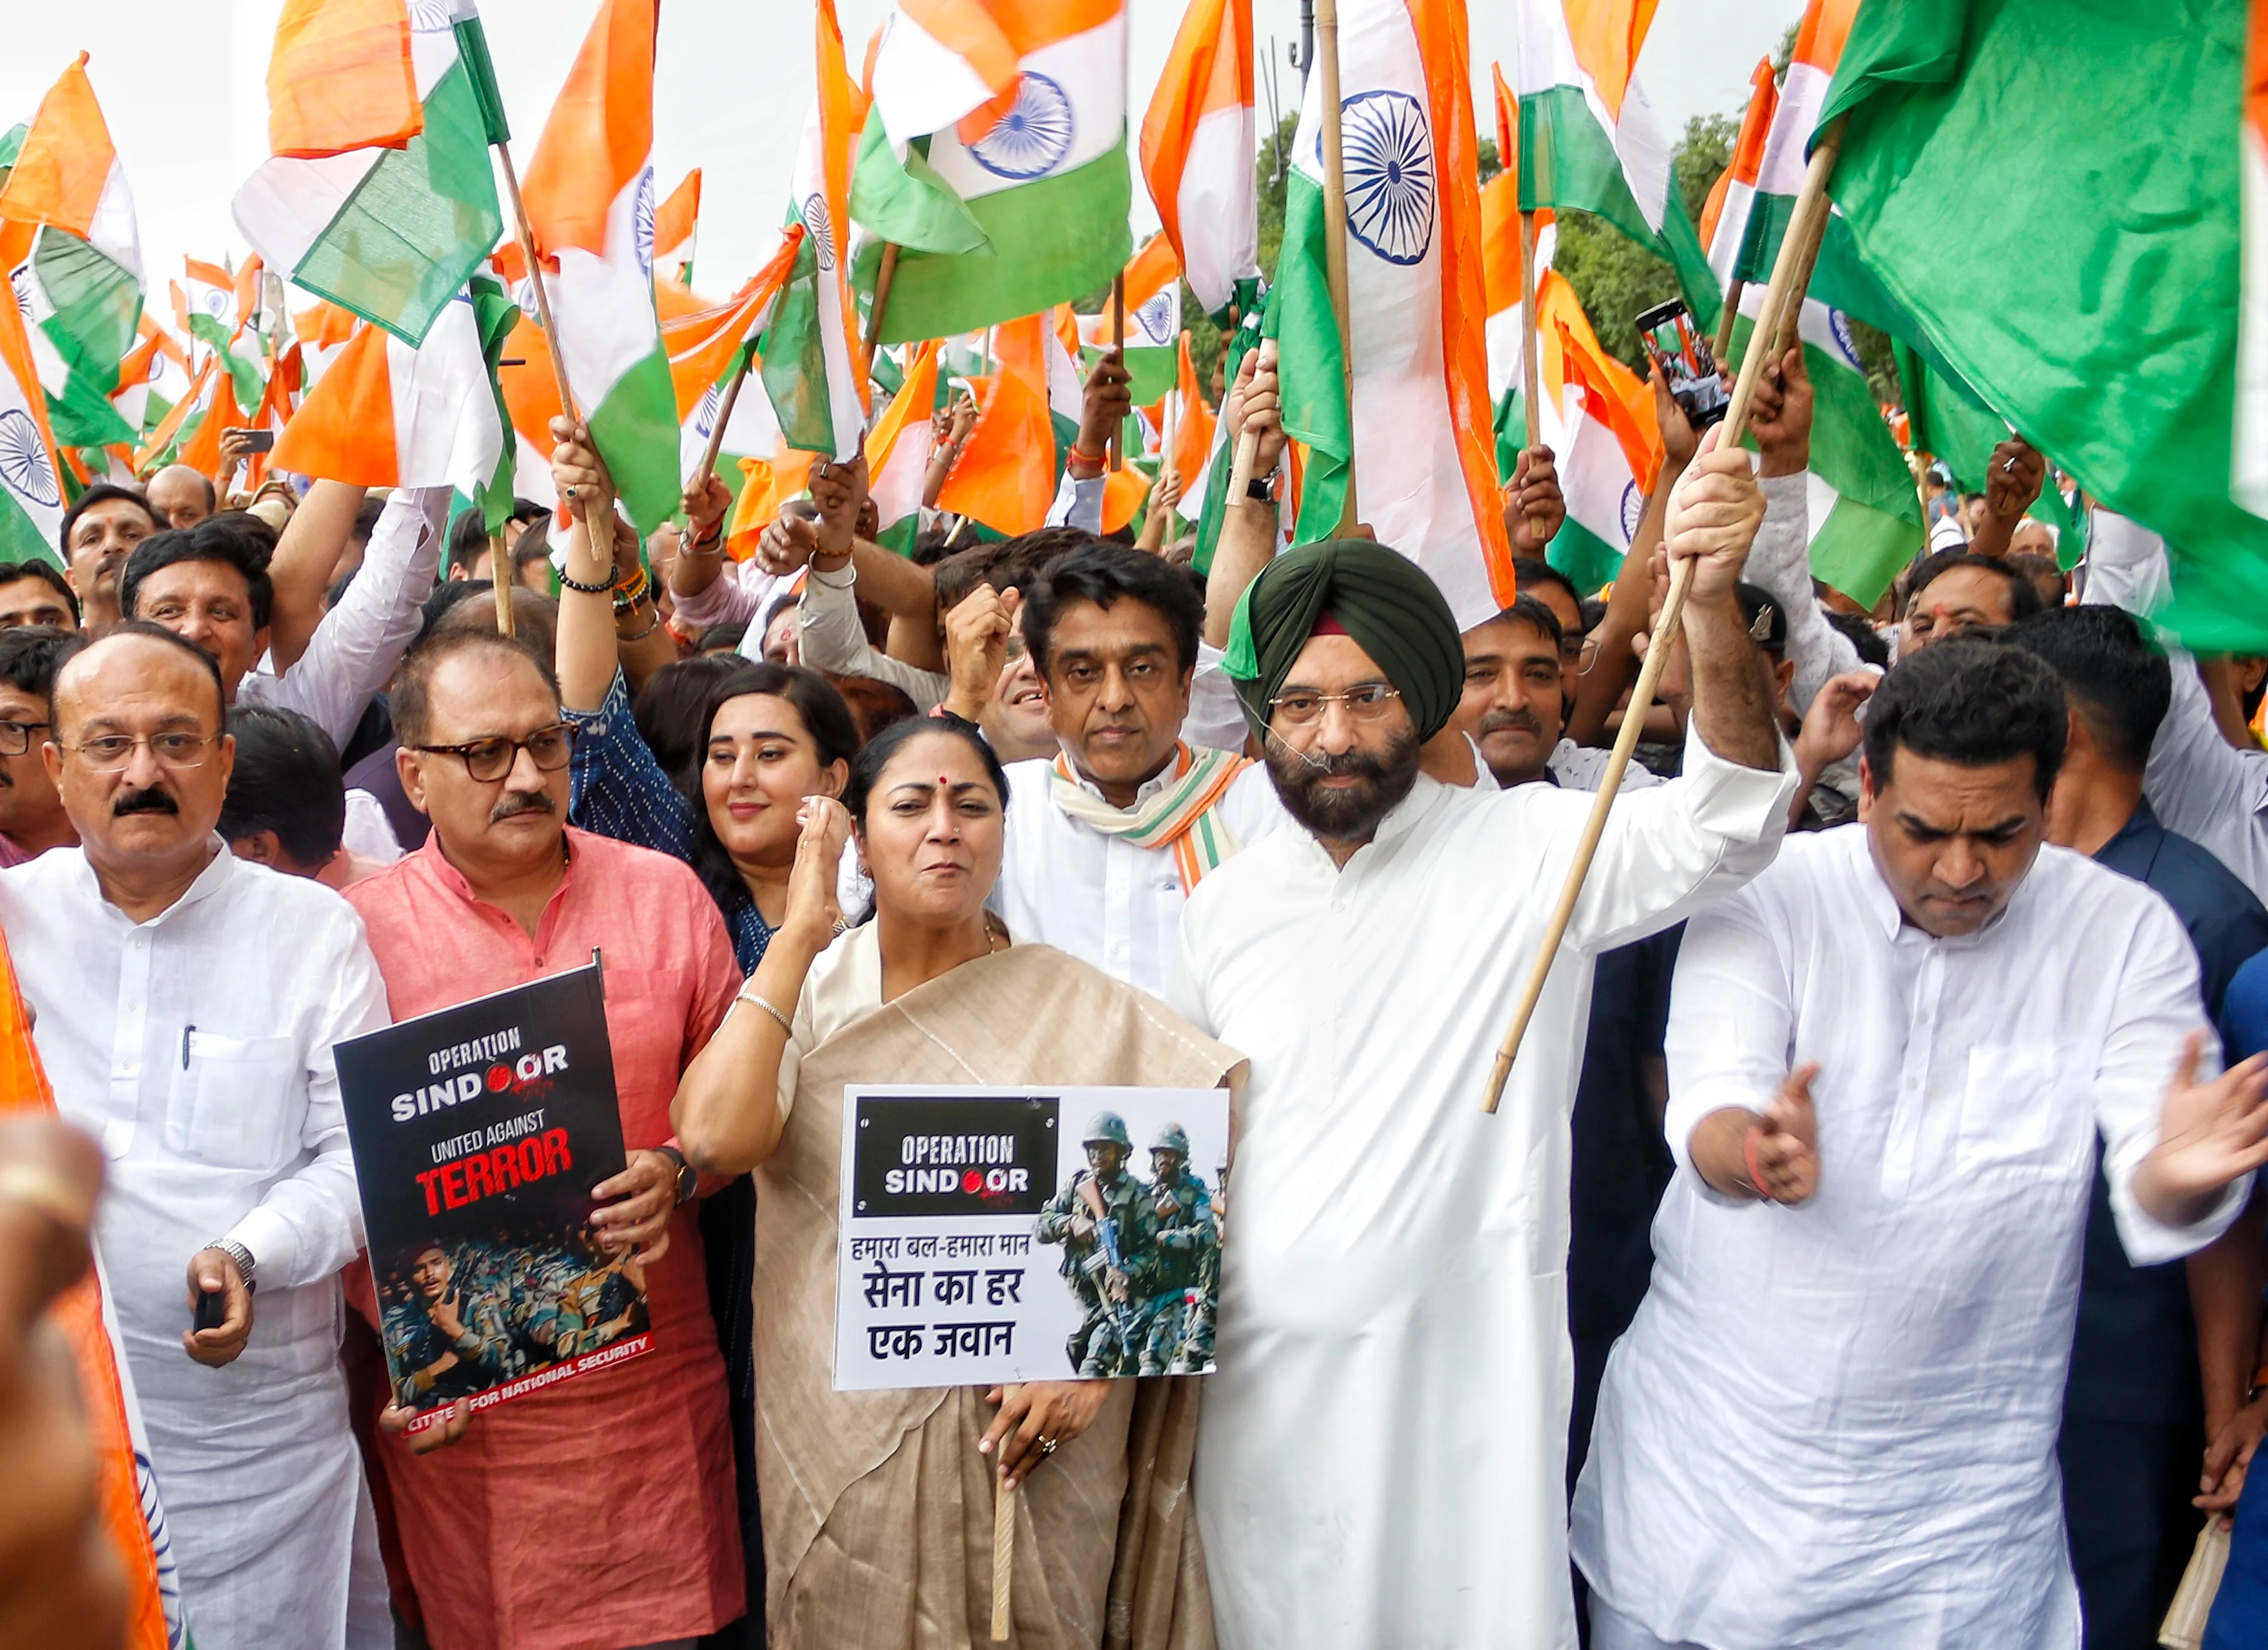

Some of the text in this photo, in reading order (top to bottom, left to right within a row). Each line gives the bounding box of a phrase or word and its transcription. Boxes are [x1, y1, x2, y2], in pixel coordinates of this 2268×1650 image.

[427, 1026, 521, 1075] OPERATION
[431, 1109, 545, 1163] UNITED AGAINST
[901, 1135, 1014, 1164] OPERATION
[416, 1127, 572, 1216] TERROR
[850, 1236, 901, 1260] हमारा
[999, 1234, 1032, 1255] मान
[862, 1260, 1025, 1308] सेना का हर
[868, 1321, 1017, 1360] एक जवान
[407, 1336, 648, 1432] CITE FOR NATIONAL SECURITY
